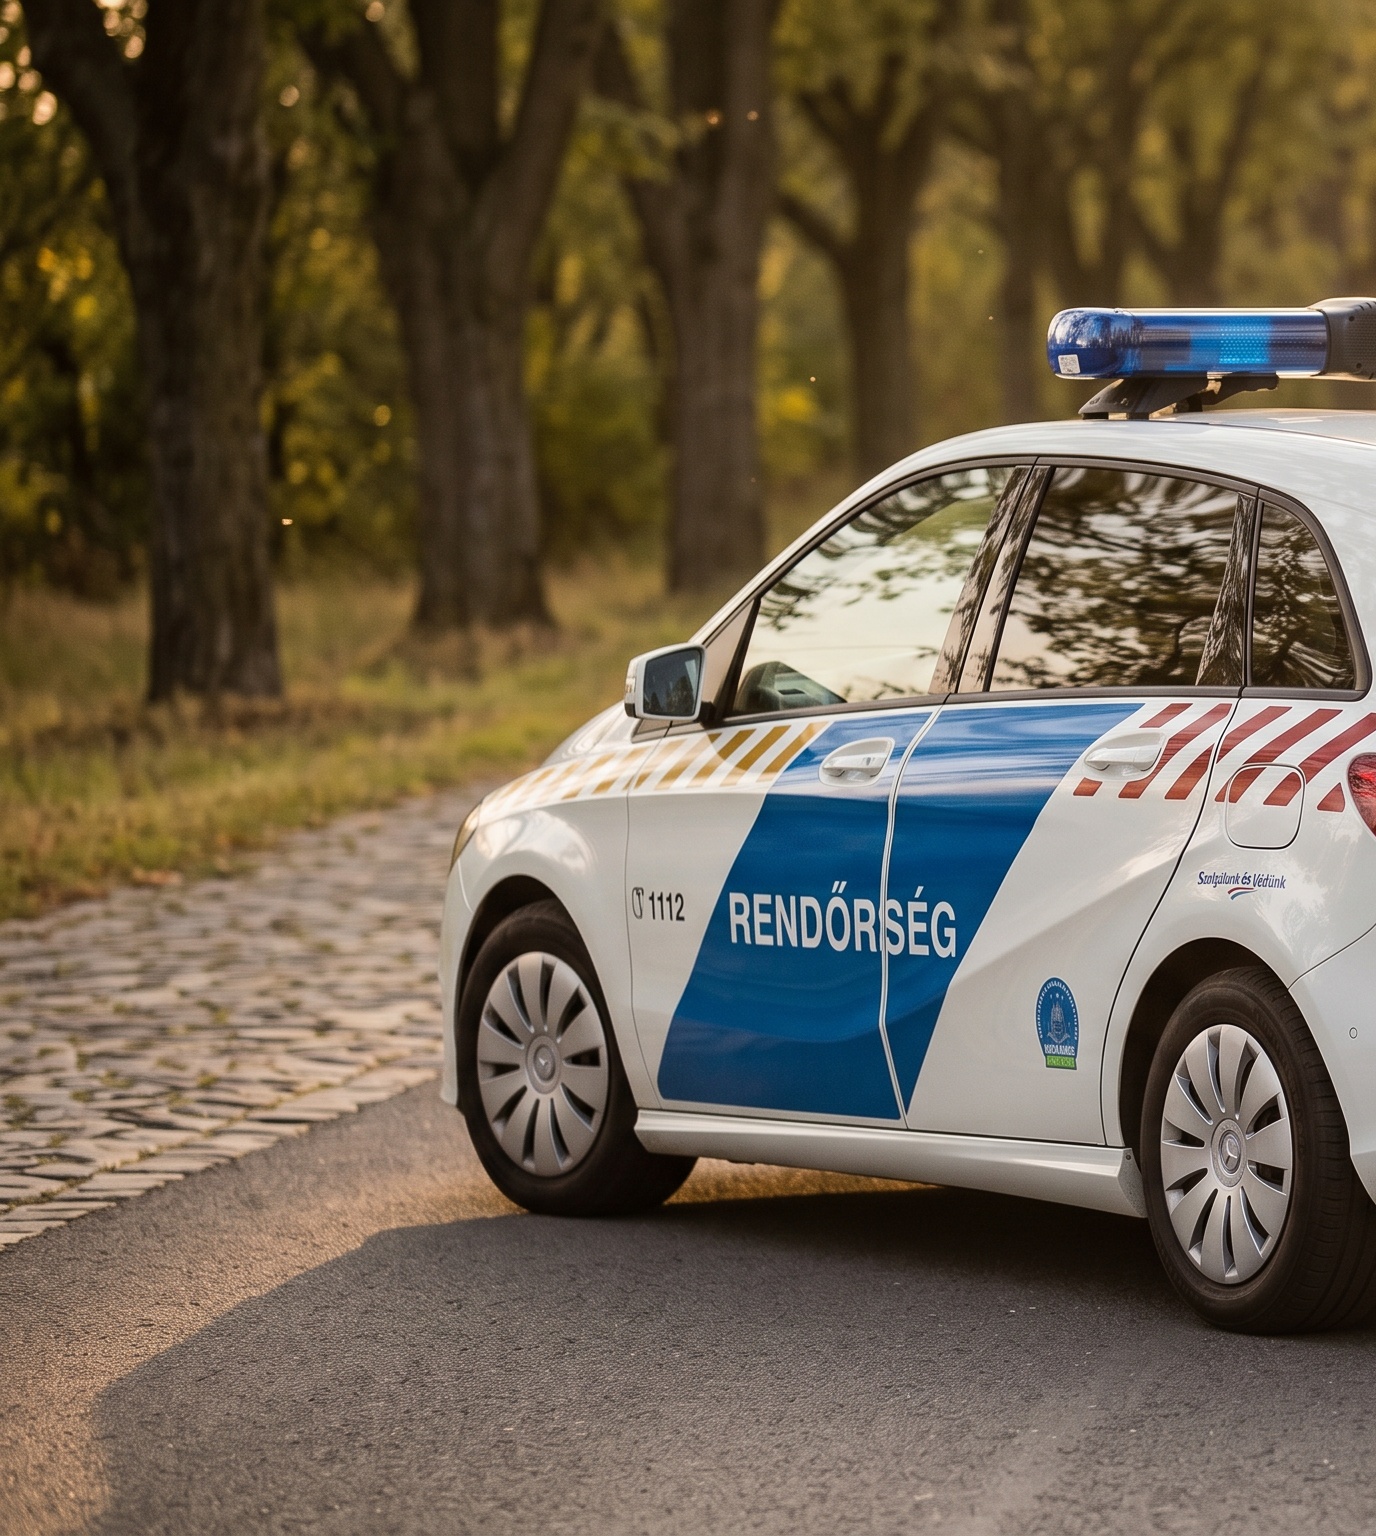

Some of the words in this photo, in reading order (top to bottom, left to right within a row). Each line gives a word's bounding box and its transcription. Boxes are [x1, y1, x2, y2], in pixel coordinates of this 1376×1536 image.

[1241, 871, 1252, 885] és
[1252, 873, 1287, 889] Védünk
[648, 890, 686, 922] 1112
[729, 880, 957, 958] RENDŐRSÉG
